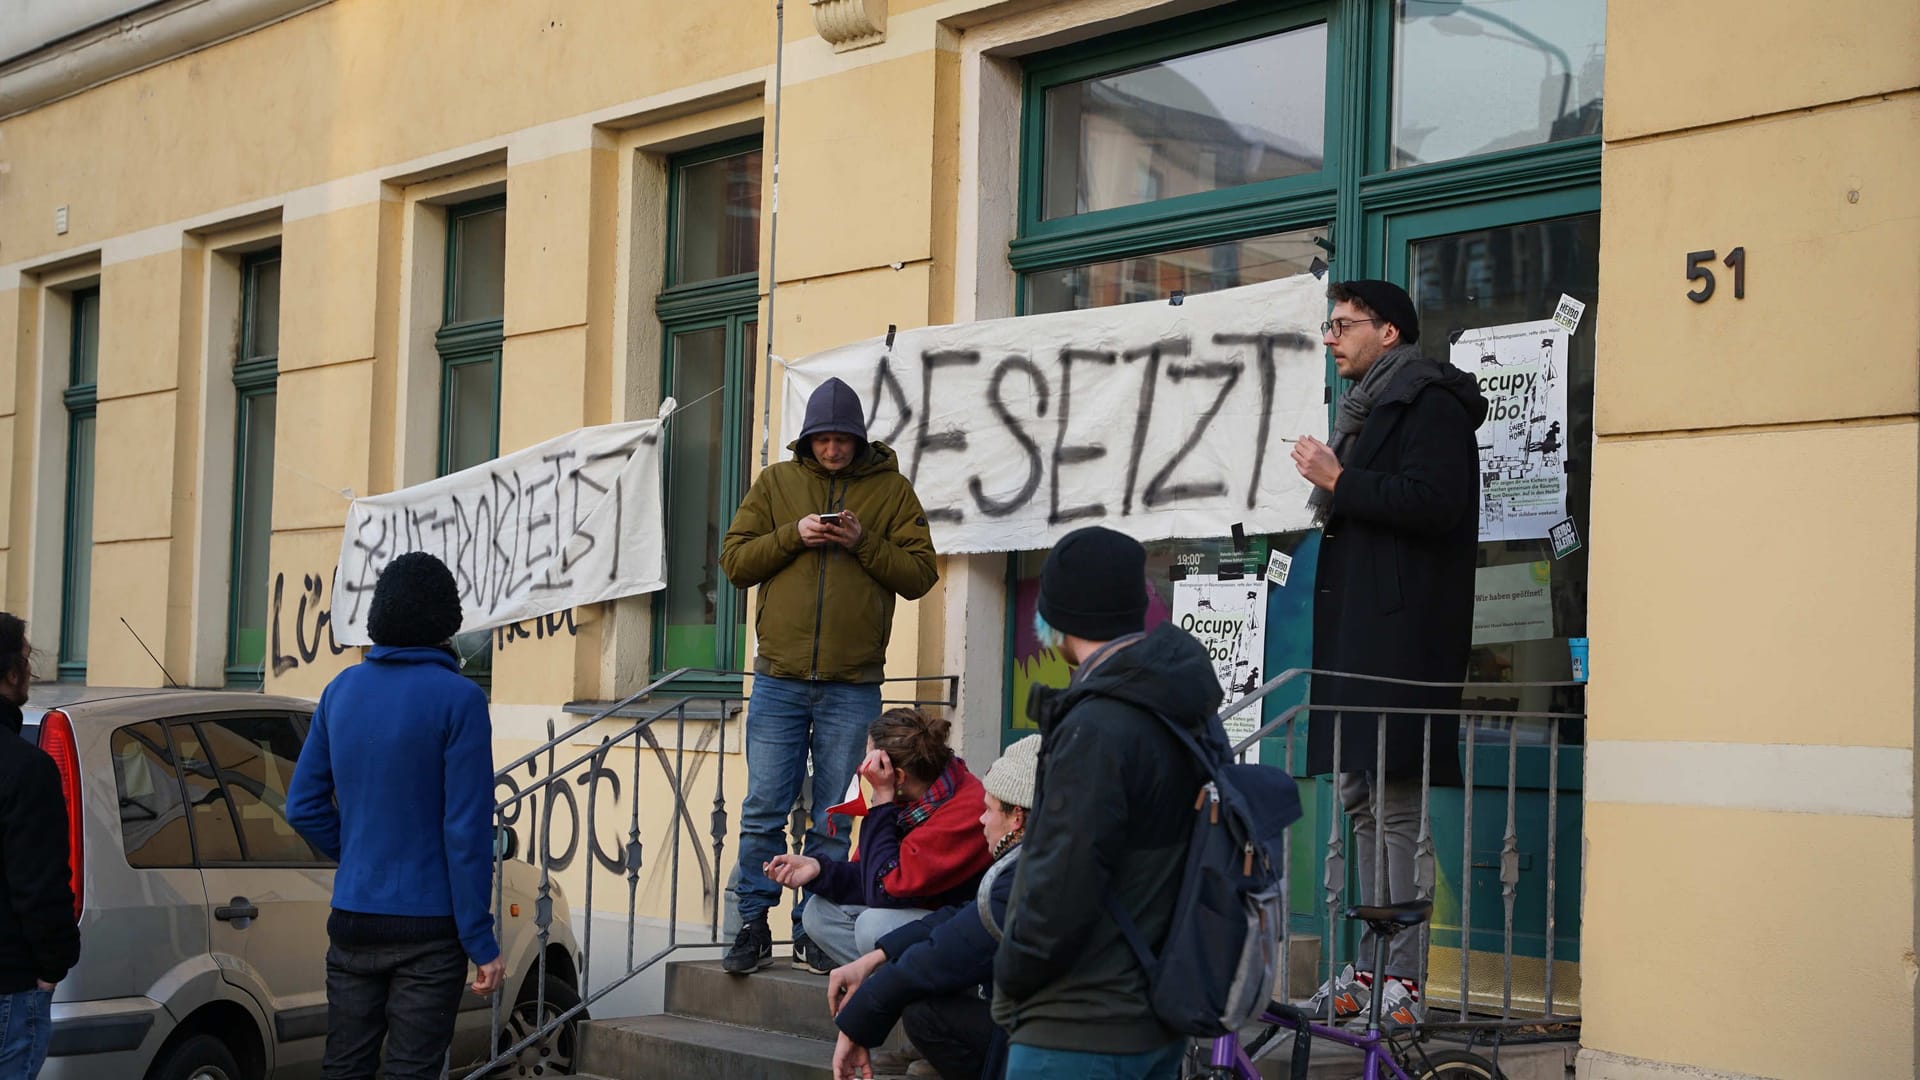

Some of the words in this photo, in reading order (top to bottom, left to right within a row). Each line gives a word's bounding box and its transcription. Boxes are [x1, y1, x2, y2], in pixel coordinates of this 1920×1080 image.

[1686, 246, 1746, 304] 51
[1555, 311, 1578, 330] BLEIBT
[1559, 303, 1579, 320] HEIBO
[1478, 372, 1538, 396] ccupy
[1488, 396, 1529, 421] ibo!
[1508, 420, 1527, 433] SWEET
[1508, 429, 1526, 441] HOME
[1475, 593, 1488, 602] Wir
[1489, 592, 1511, 601] haben
[1511, 588, 1544, 601] geöffnet!
[1181, 613, 1243, 639] Occupy
[1204, 639, 1235, 662] bo!
[1334, 993, 1360, 1016] N
